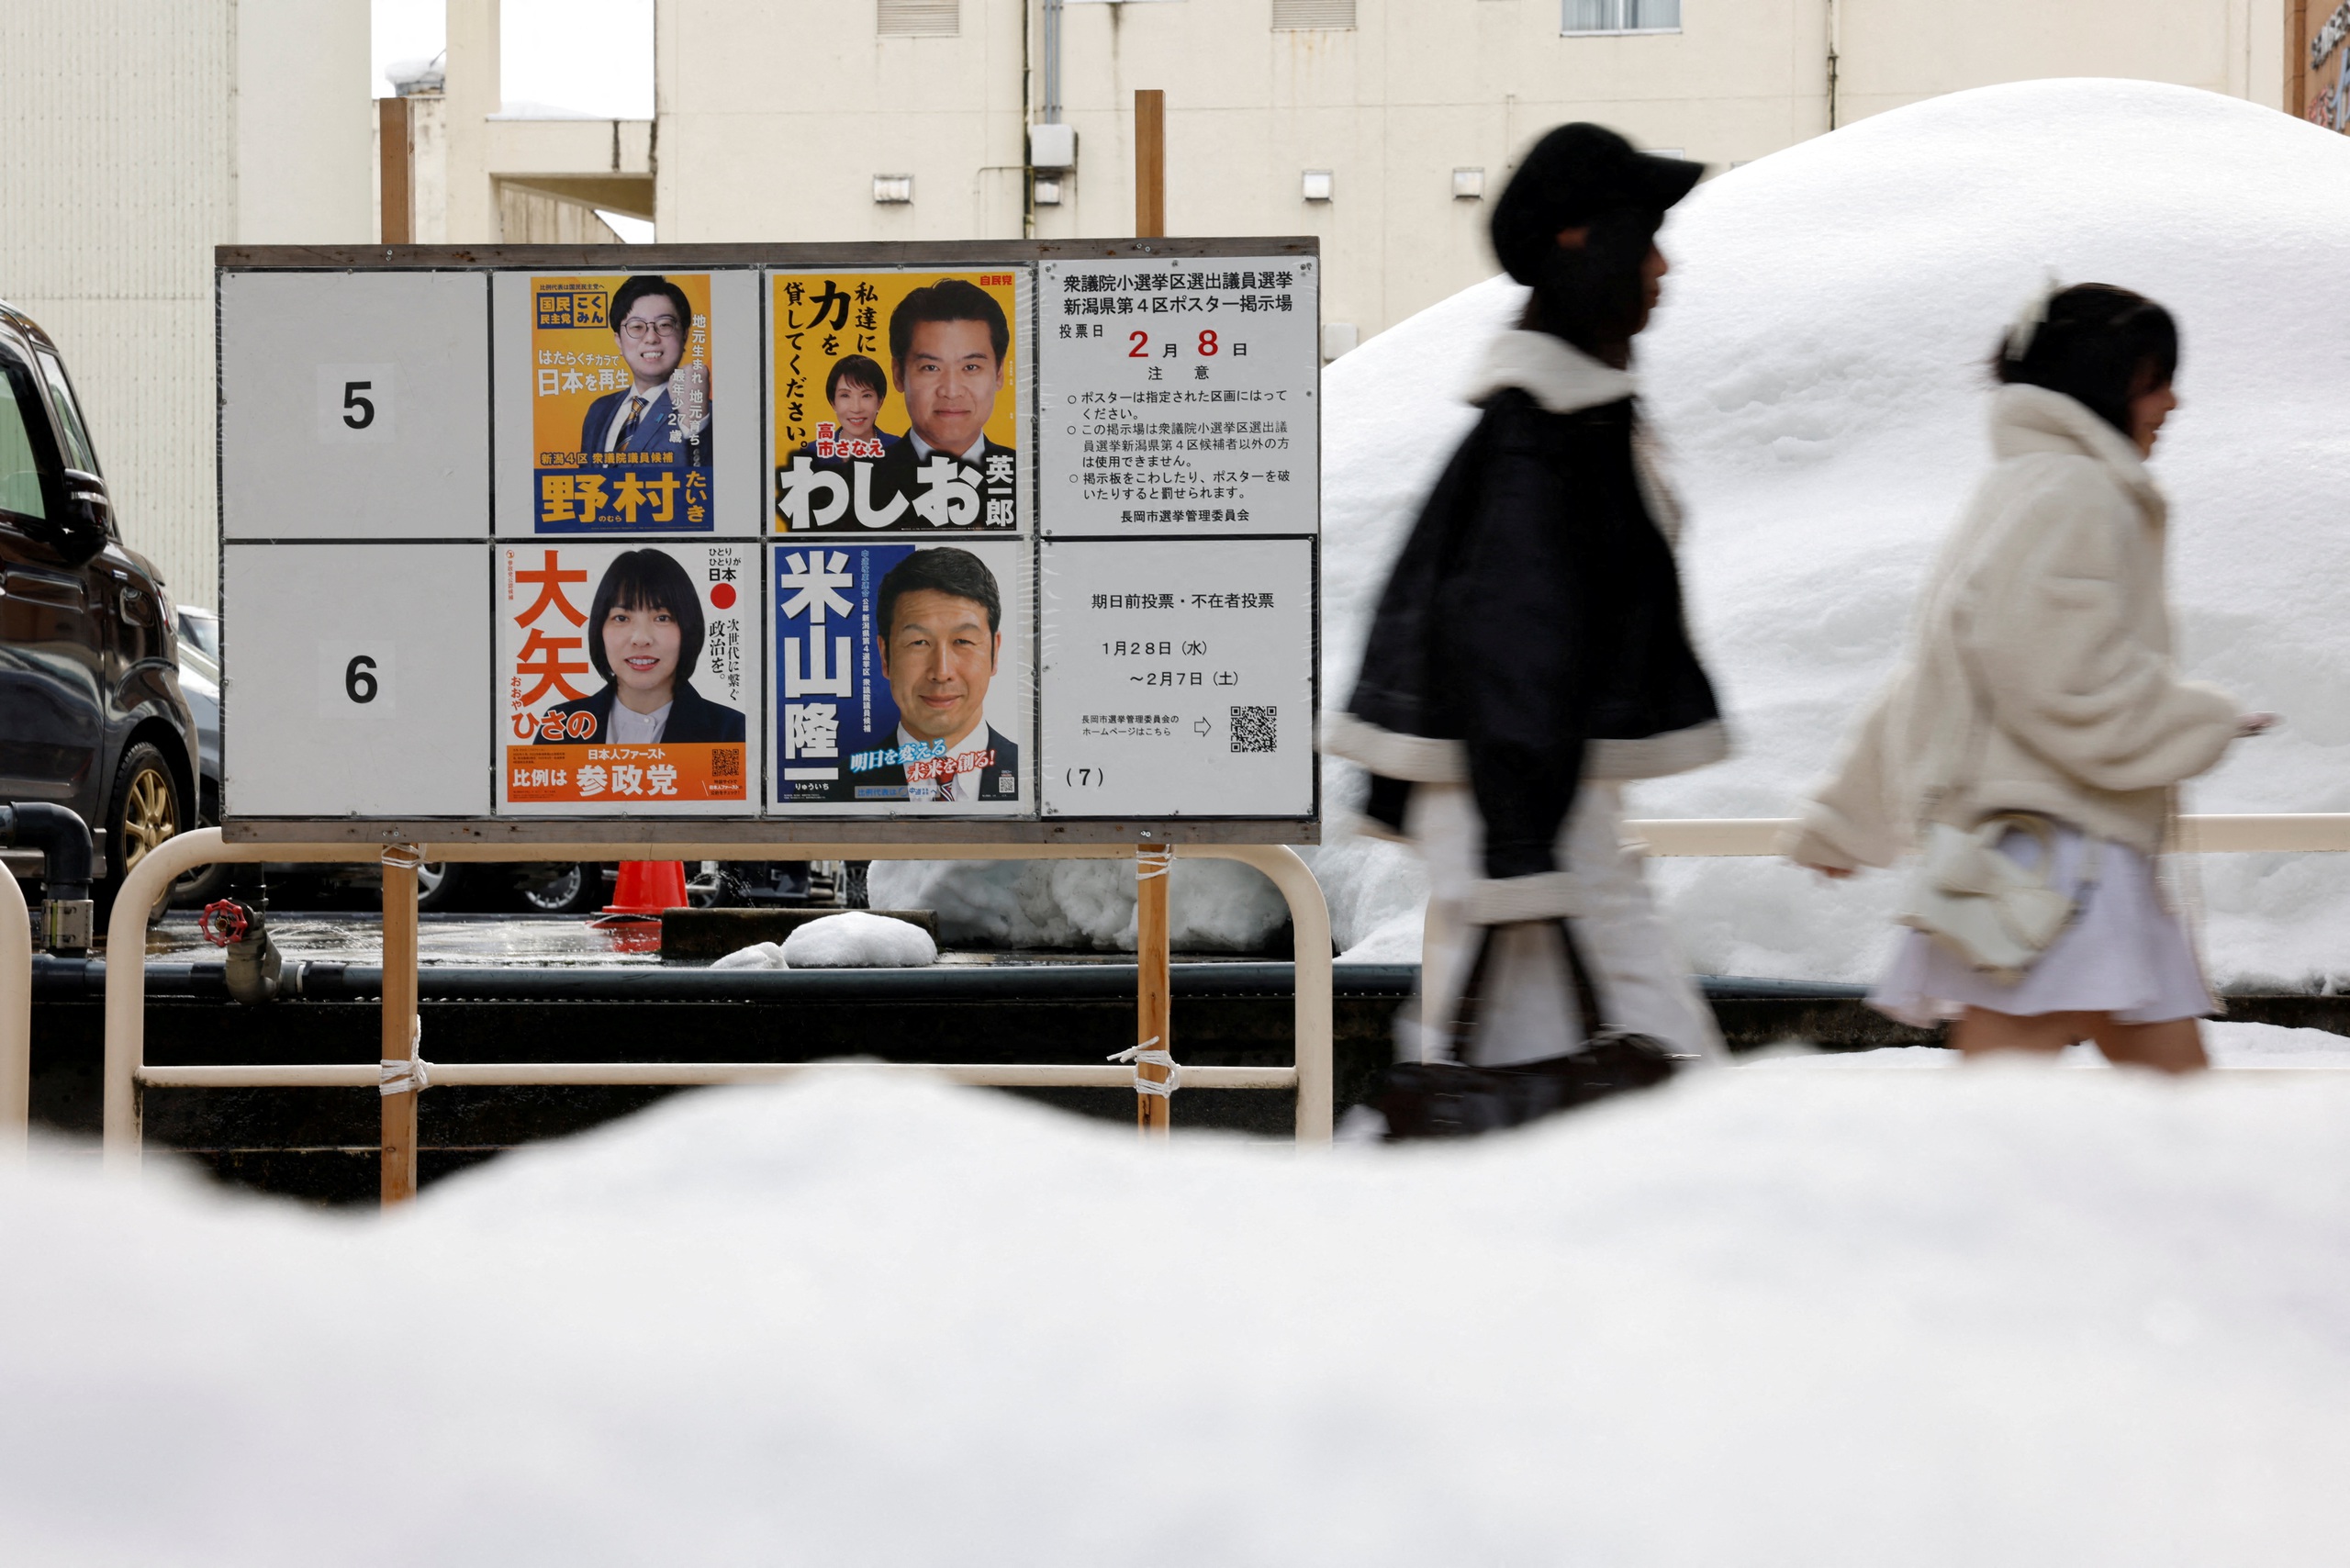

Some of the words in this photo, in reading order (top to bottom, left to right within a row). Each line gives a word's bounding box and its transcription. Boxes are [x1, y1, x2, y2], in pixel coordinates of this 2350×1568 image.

[540, 283, 605, 291] 比例代表は国民民主党へ
[979, 275, 1013, 286] 自民党
[1063, 271, 1293, 293] 衆議院小選挙区選出議員選挙
[1063, 294, 1292, 315] 新潟県第4区ポスター掲示場
[540, 314, 571, 325] 民主党
[806, 280, 852, 356] 力を
[854, 281, 878, 353] 私達に
[1058, 324, 1103, 339] 投票日
[538, 350, 620, 366] はたらくチカラで
[783, 282, 808, 448] 貸してください。
[537, 367, 630, 398] 日本を再生
[342, 381, 375, 430] 5
[1081, 389, 1288, 404] ポスターは指定された区画にはって
[1082, 408, 1139, 420] ください。
[1081, 420, 1289, 435] この掲示場は衆議院小選挙区選出議
[541, 452, 588, 465] 新潟4区
[592, 452, 674, 465] 衆議院議員候補
[1082, 455, 1192, 468] は使用できません。
[1083, 470, 1291, 486] 掲示板をこわしたり、ポスターを破
[541, 472, 681, 522] 野村
[686, 470, 708, 522] たいき
[778, 455, 984, 529] わしお
[985, 455, 1014, 527] 英一郎
[1083, 486, 1246, 500] いたりすると罰せられます。
[1120, 510, 1249, 523] 長岡市選挙管理委員会
[709, 557, 742, 566] ひとりが
[709, 567, 737, 582] 日本
[1091, 593, 1274, 610] 期日前投票・不在者投票
[513, 549, 589, 708] 大矢
[709, 621, 726, 679] 政治を。
[727, 618, 740, 701] 次世代に繋ぐ
[780, 550, 855, 780] 米山隆一
[345, 655, 378, 704] 6
[510, 676, 522, 711] おおや
[511, 710, 598, 740] ひさの
[1081, 714, 1180, 724] 長岡市選挙管理委員会の
[1082, 727, 1171, 736] ホームページはこちら
[588, 748, 666, 761] 日本人ファースト
[850, 738, 946, 773] 明日を変える
[512, 768, 568, 787] 比例は
[576, 764, 678, 797] 参政党
